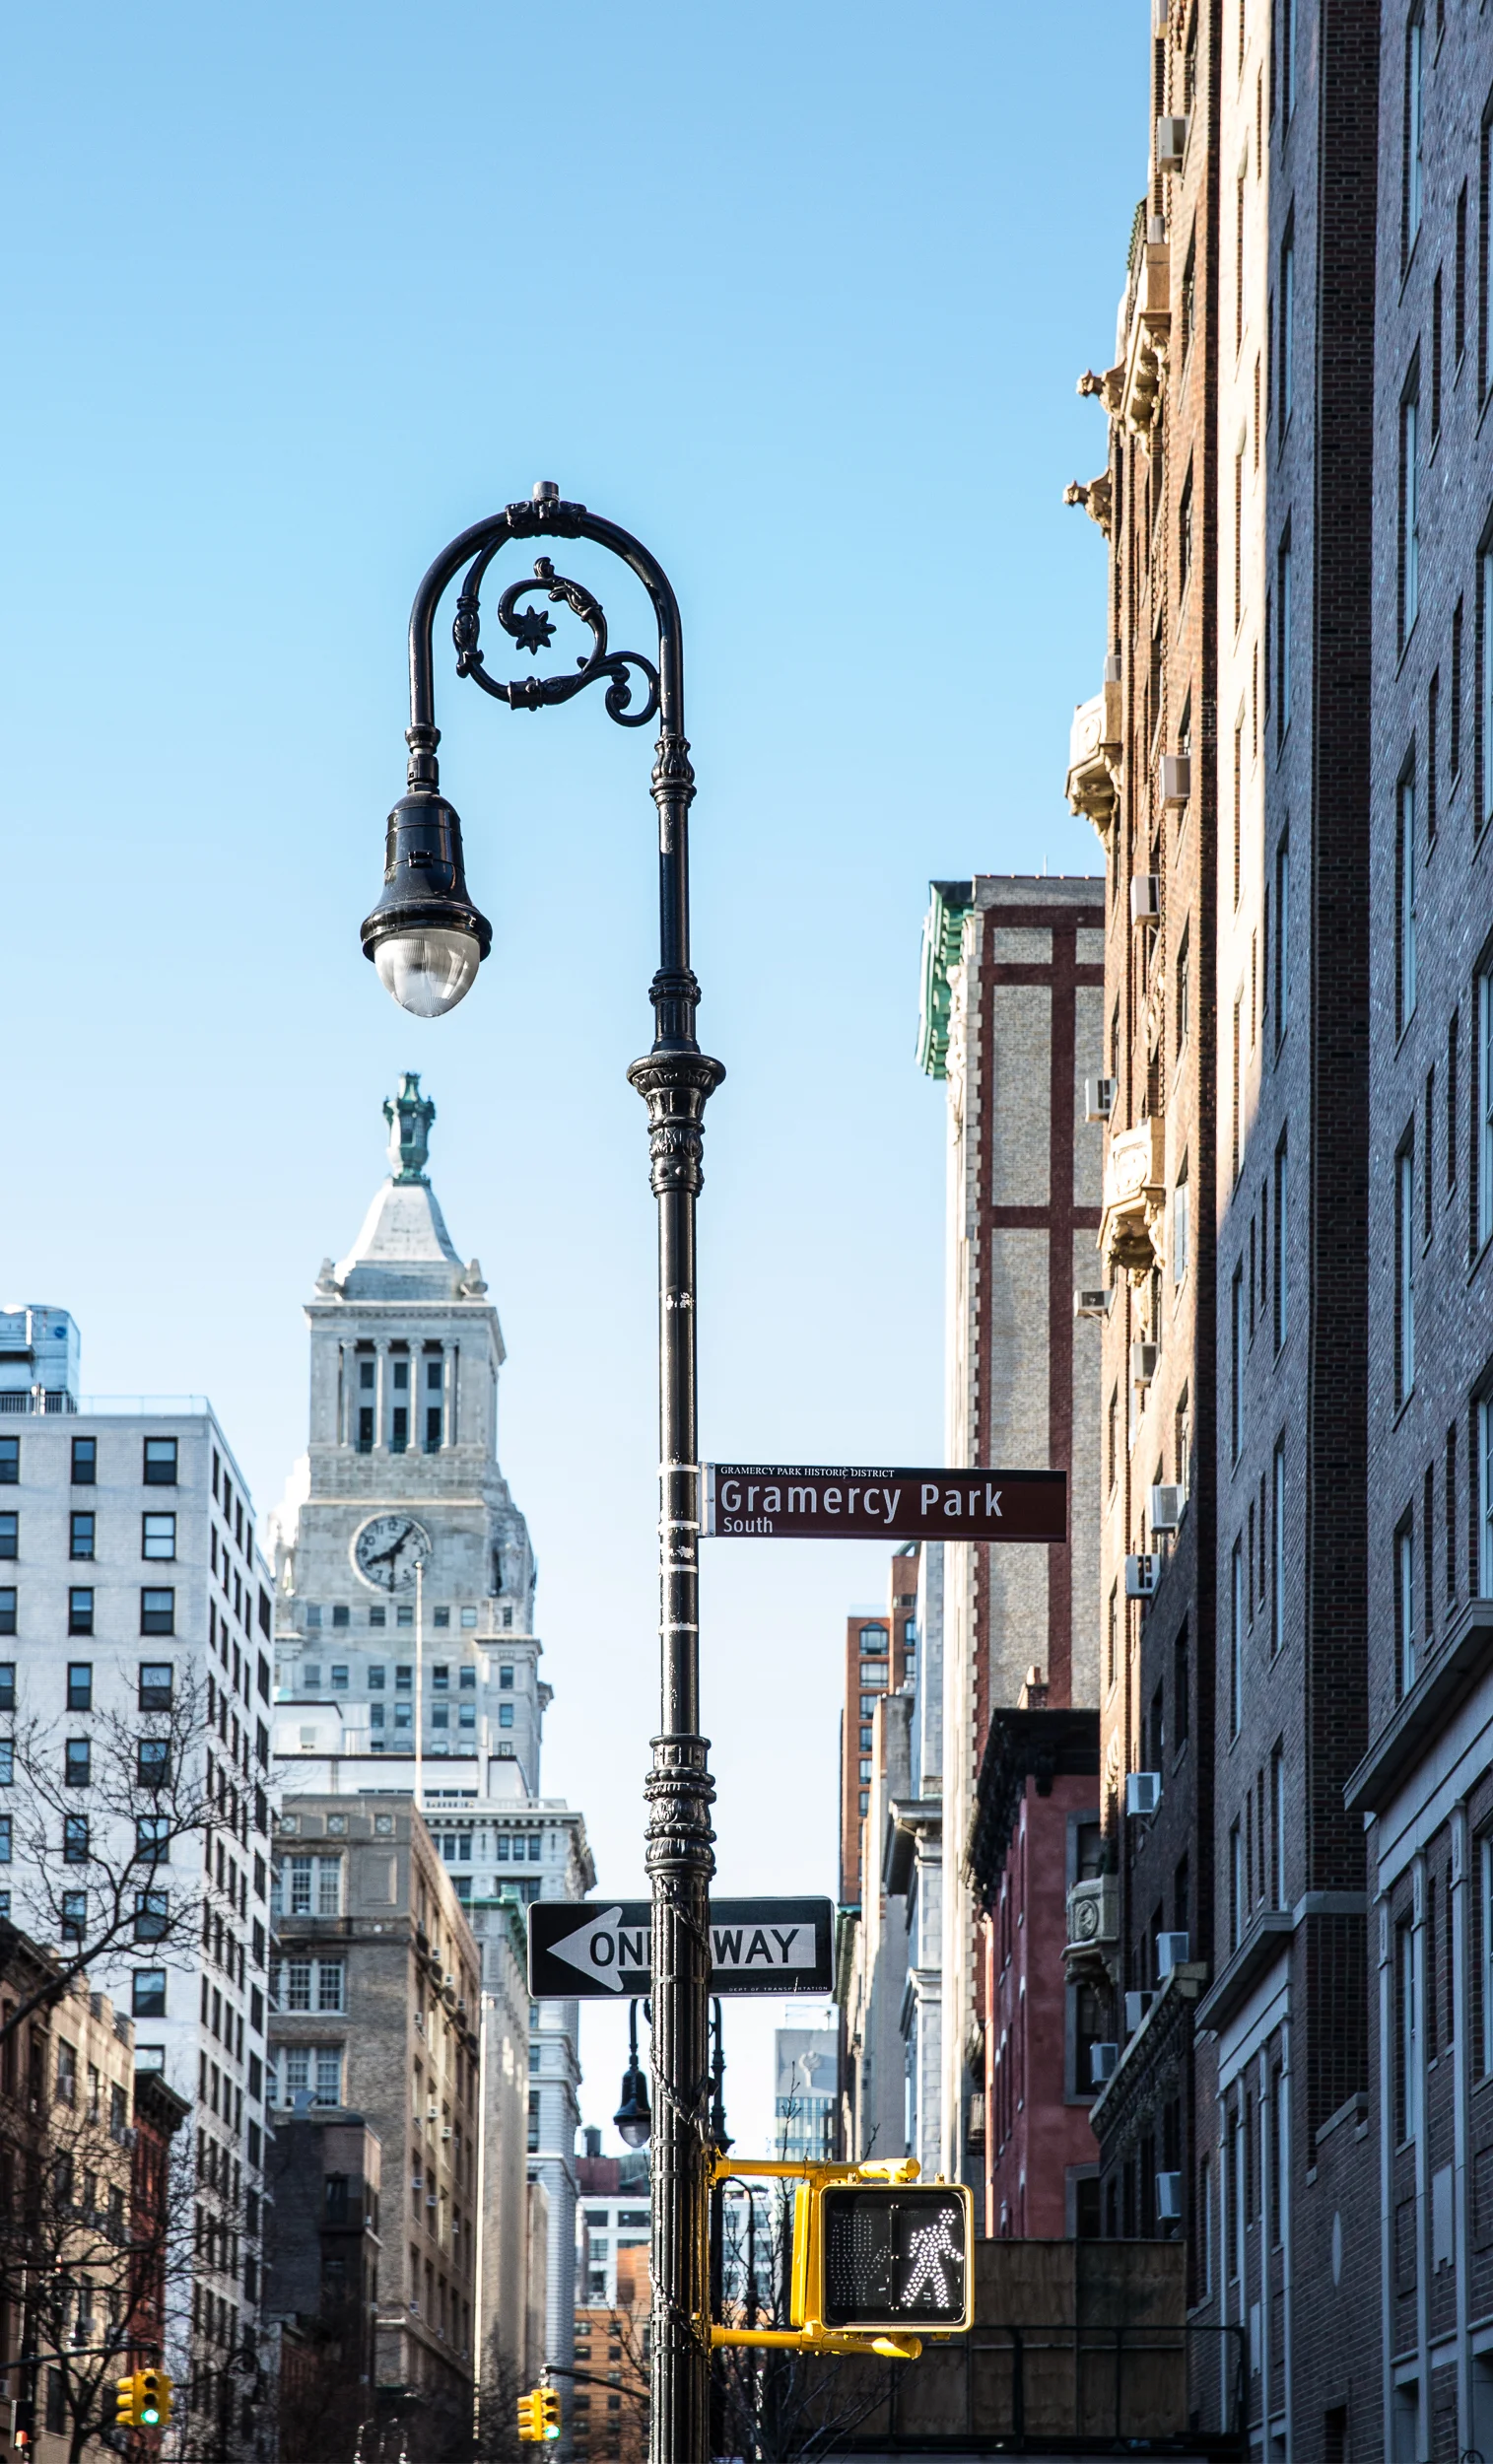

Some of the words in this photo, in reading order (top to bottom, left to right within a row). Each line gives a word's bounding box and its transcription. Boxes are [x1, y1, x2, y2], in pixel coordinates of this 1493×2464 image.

[720, 1466, 776, 1475] GRAMERCY
[804, 1468, 848, 1476] HISTORIC
[850, 1469, 895, 1477] DISTRICT
[720, 1479, 901, 1524] Gramercy
[920, 1483, 1003, 1517] Park
[723, 1516, 773, 1534] South
[589, 1931, 651, 1967] ON
[713, 1928, 799, 1964] WAY
